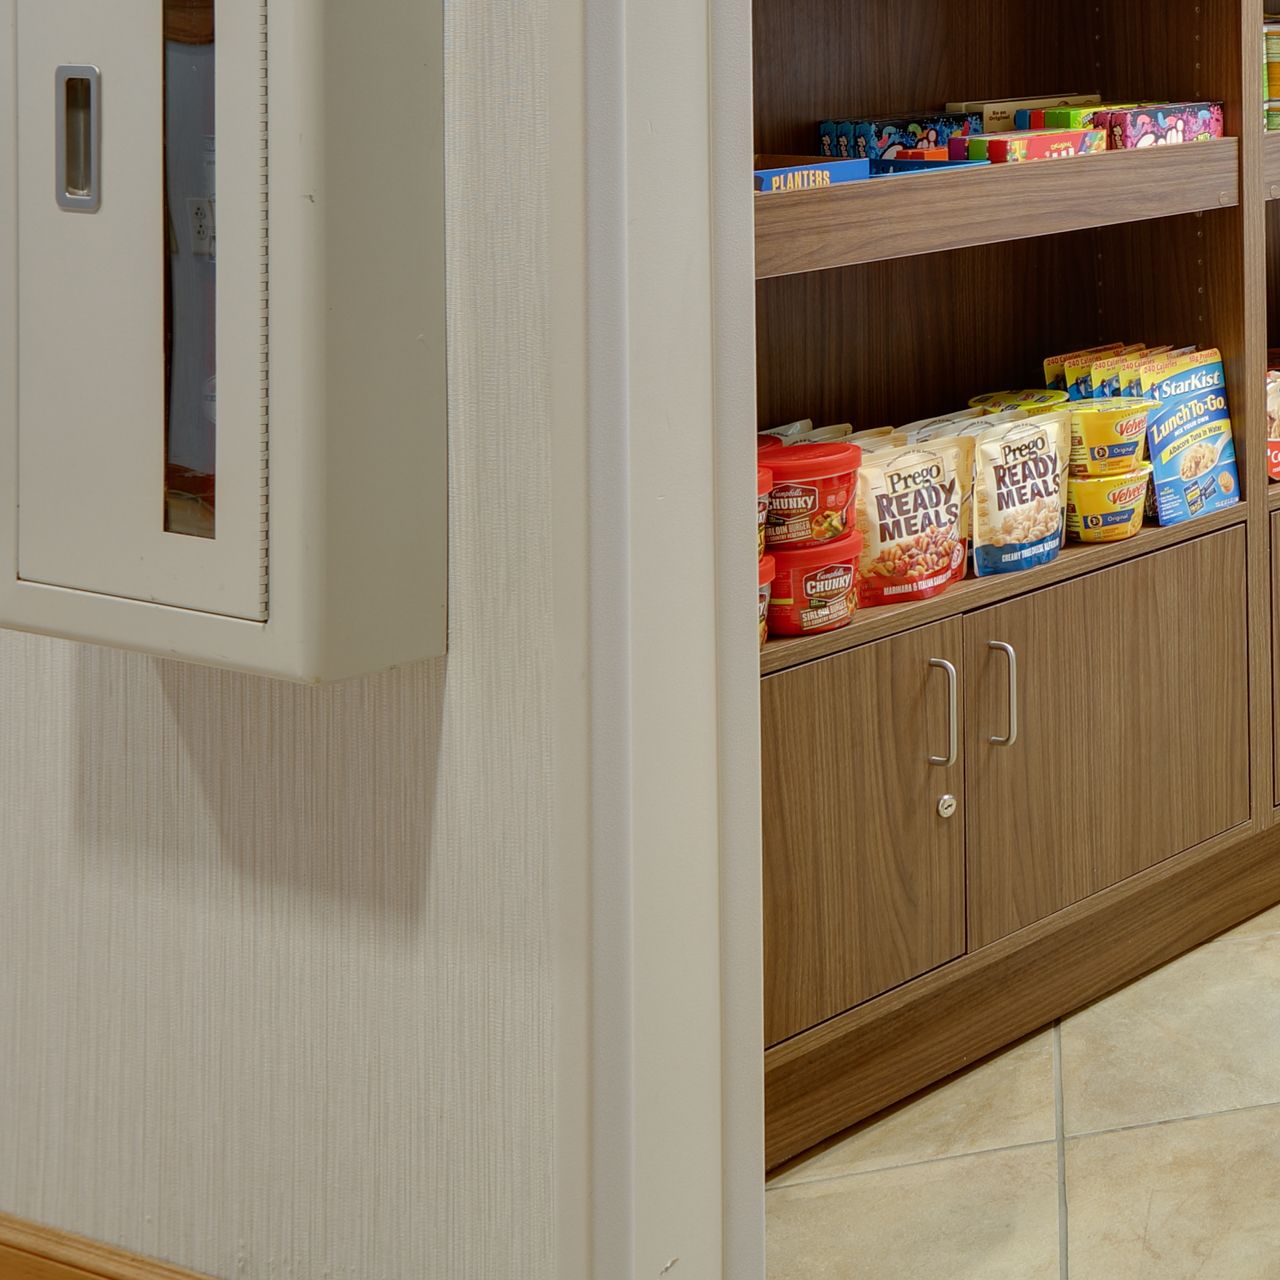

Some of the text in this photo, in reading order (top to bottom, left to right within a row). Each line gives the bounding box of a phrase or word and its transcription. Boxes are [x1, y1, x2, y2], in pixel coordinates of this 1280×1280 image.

[772, 170, 830, 191] PLANTERS
[1162, 370, 1220, 398] StarKist
[1151, 403, 1191, 445] Lunch
[1002, 435, 1046, 465] Prego
[1169, 425, 1222, 456] Albacore Tuna Water
[888, 463, 941, 494] Prego
[993, 453, 1058, 491] READY
[875, 477, 956, 519] READY
[997, 474, 1061, 512] MEALS
[879, 503, 959, 543] MEALS
[806, 573, 850, 593] CHUNKY
